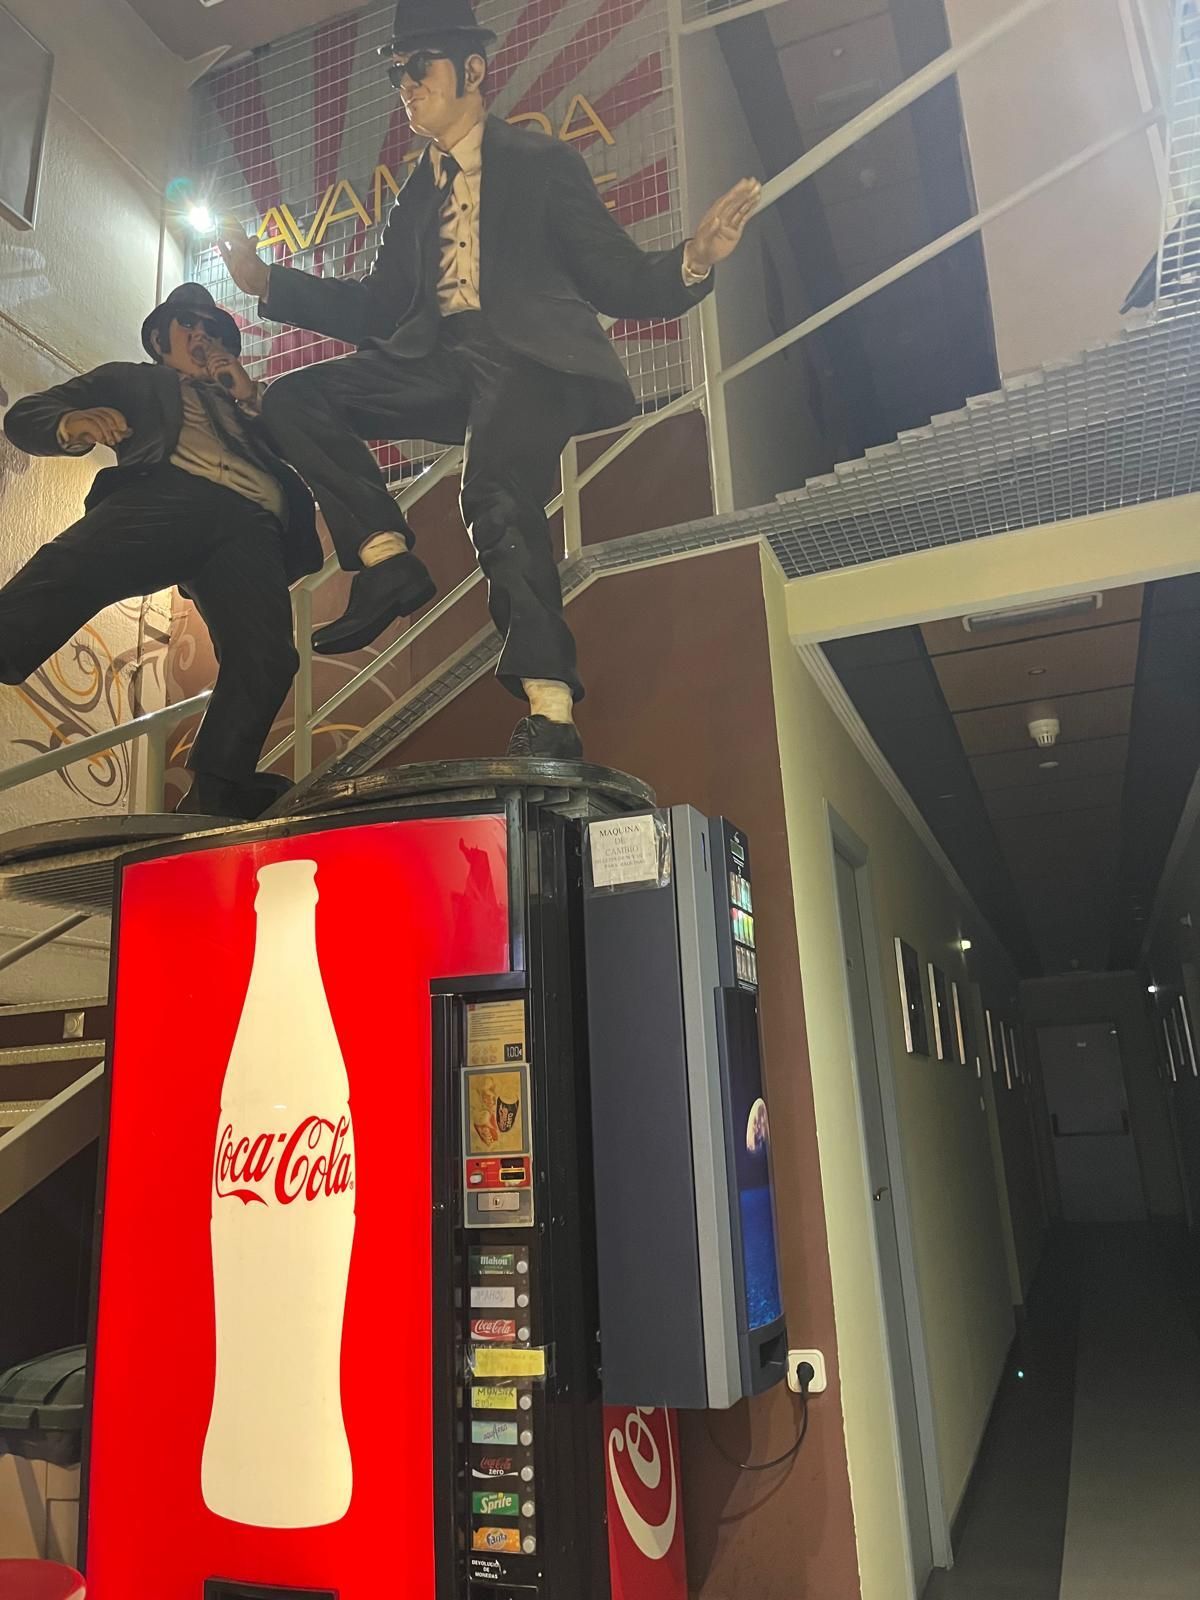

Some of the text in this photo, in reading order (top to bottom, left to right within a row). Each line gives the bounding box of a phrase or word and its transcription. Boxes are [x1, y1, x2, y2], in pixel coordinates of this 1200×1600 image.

[599, 825, 640, 838] MAQUINA
[614, 837, 626, 845] DE
[605, 845, 639, 857] CAMBIO
[216, 1116, 351, 1207] Coca-Cola
[480, 1255, 508, 1265] Mahou
[474, 1319, 513, 1334] Coca-Cola
[480, 1492, 512, 1514] Sprite
[486, 1533, 508, 1546] Fanta
[474, 1571, 498, 1580] MONEDAS
